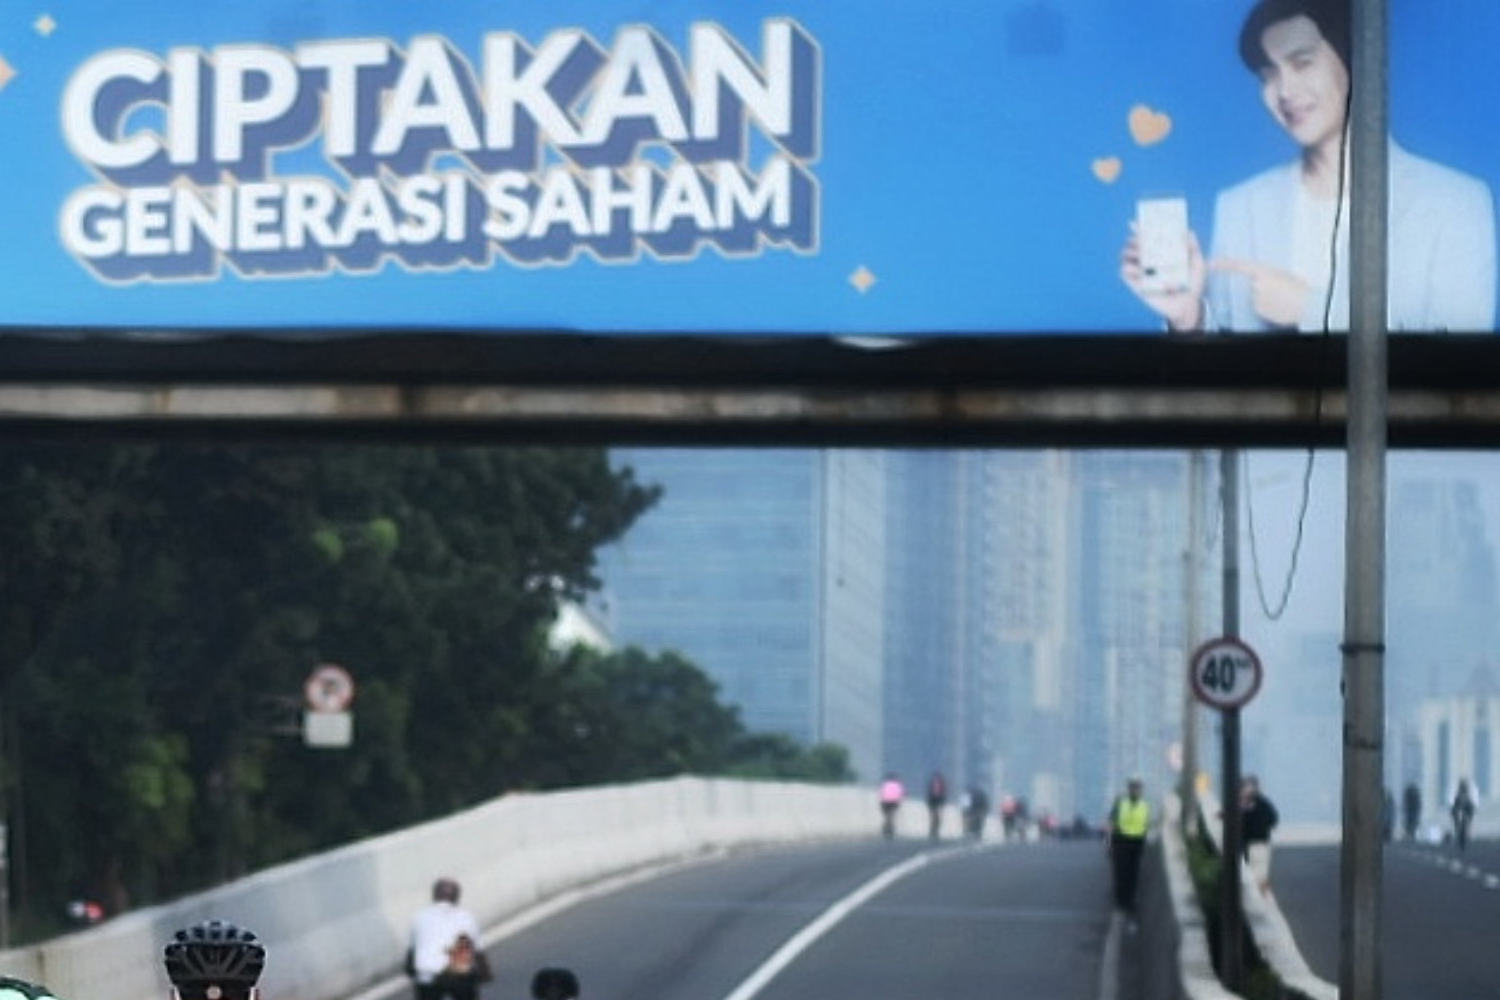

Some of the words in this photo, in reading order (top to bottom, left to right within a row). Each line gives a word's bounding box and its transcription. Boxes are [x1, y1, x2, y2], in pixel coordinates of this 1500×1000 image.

[60, 17, 800, 170] CIPTAKAN
[60, 173, 468, 260] GENERASI
[482, 158, 794, 244] SAHAM
[1202, 656, 1235, 693] 40
